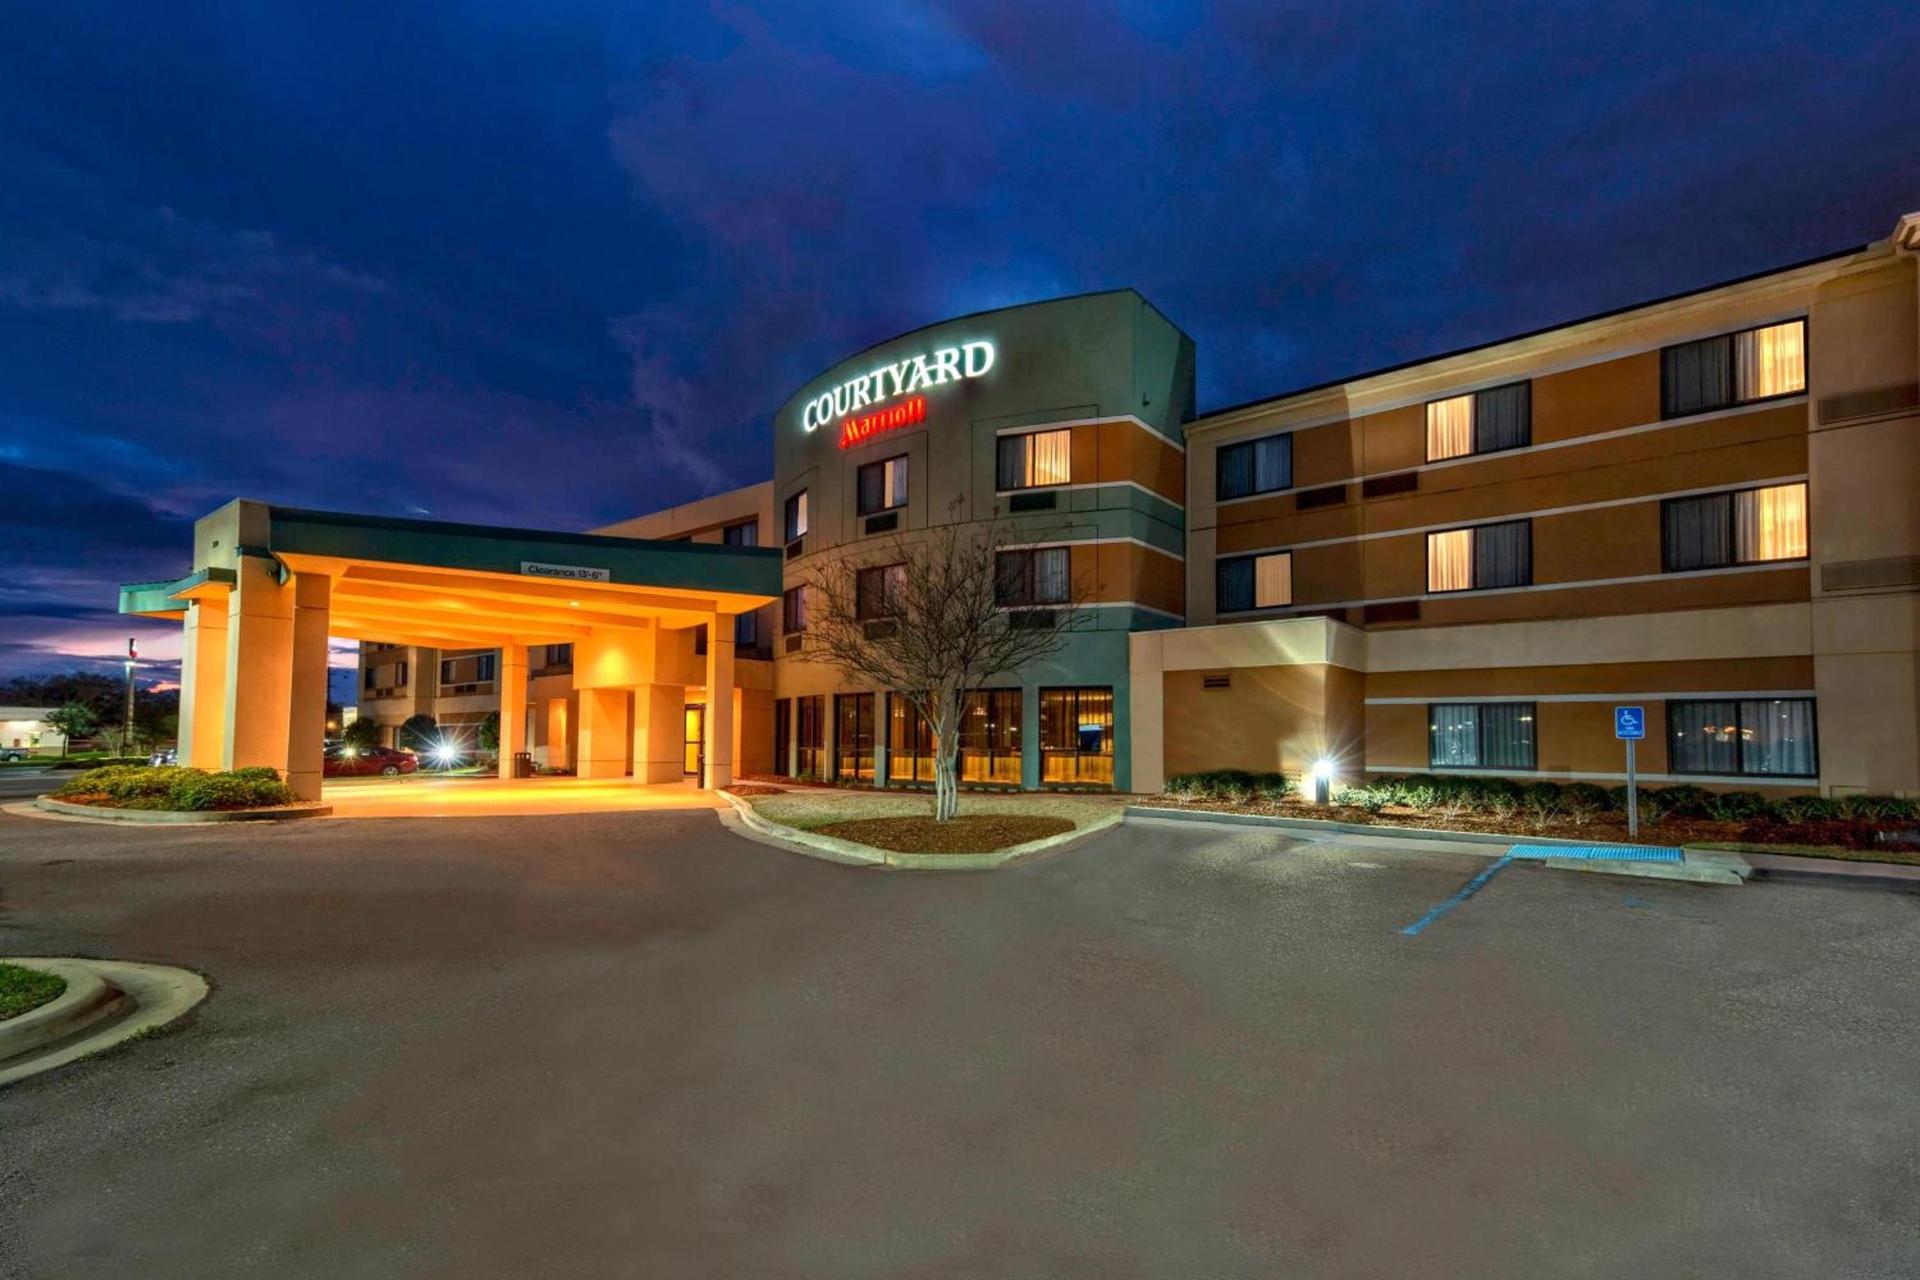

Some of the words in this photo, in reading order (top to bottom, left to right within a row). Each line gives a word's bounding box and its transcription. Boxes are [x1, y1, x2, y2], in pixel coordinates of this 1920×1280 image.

[803, 341, 995, 433] COURTYARD
[840, 397, 925, 447] Marriott
[528, 565, 576, 577] Clearance
